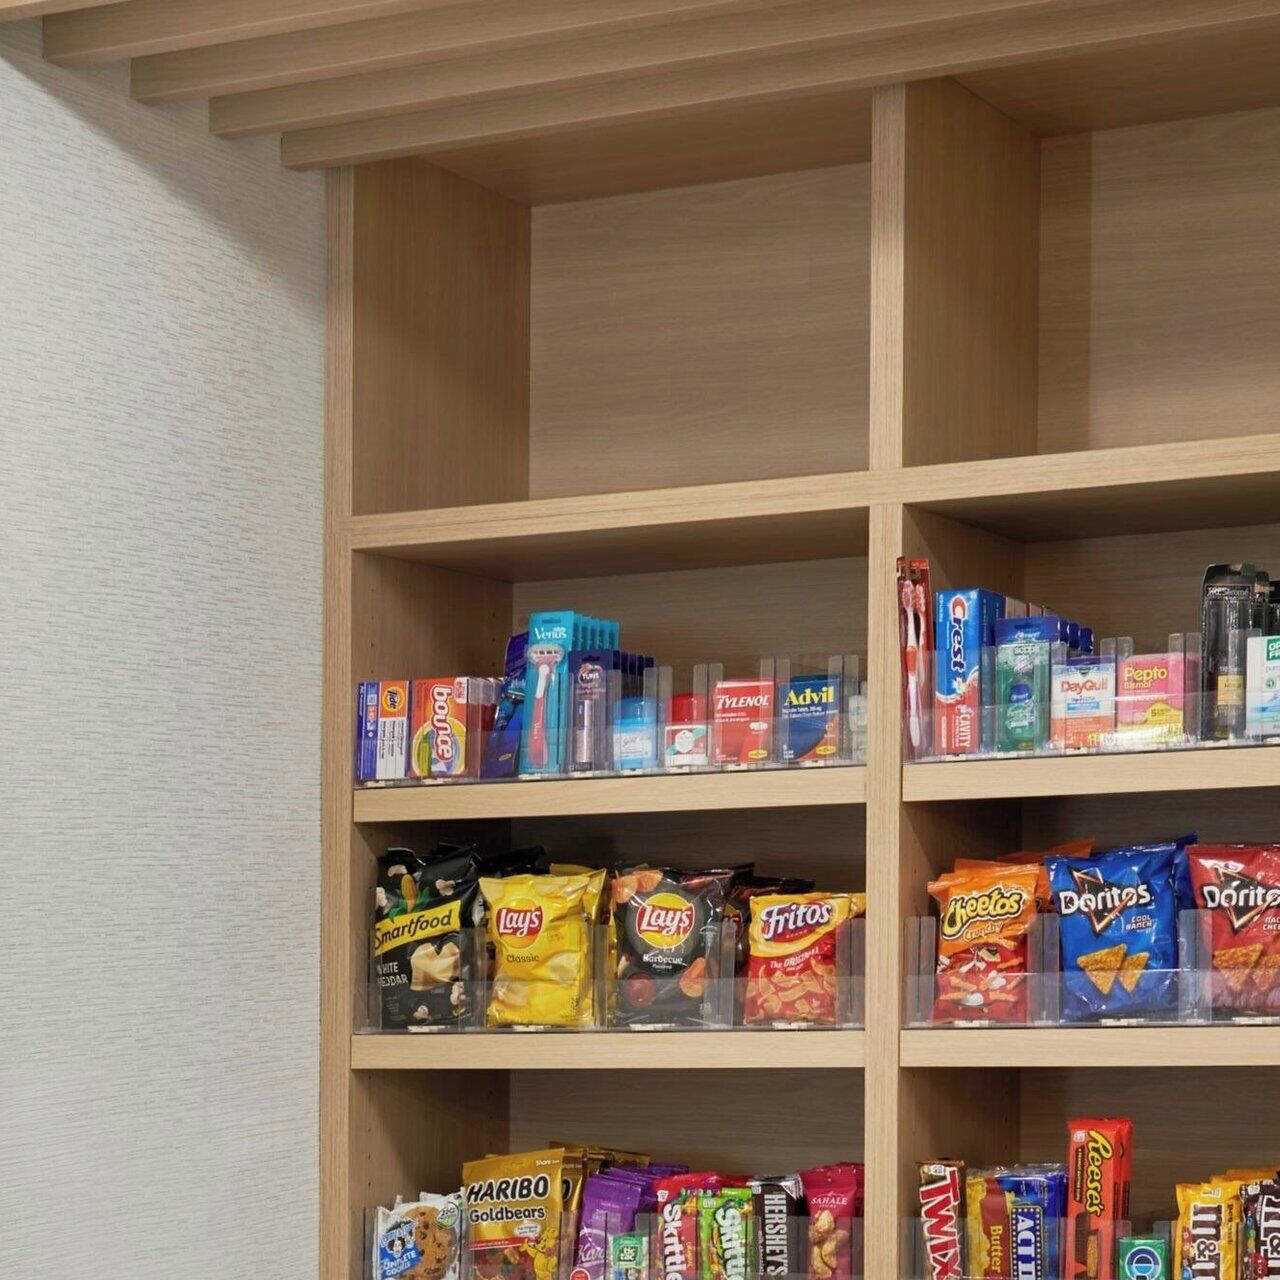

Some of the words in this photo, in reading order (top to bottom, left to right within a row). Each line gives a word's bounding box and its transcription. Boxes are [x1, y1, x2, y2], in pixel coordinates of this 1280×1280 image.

[535, 627, 567, 640] Venus
[950, 595, 968, 674] Crest
[1124, 666, 1168, 682] Pepto
[1060, 679, 1108, 694] DayQuil
[1124, 679, 1152, 690] Bismol
[716, 694, 769, 710] TYLENOL
[784, 686, 835, 706] Advil
[433, 685, 454, 761] bounce
[1059, 883, 1152, 914] Doritos
[640, 904, 693, 936] Lay's
[761, 902, 832, 940] Fritos
[942, 886, 1024, 938] Cheetos
[1130, 914, 1152, 923] COOL
[374, 909, 452, 950] Smartfood
[499, 906, 543, 938] Lay's
[964, 921, 1004, 940] Crunchy
[1125, 920, 1153, 931] RANCH
[506, 954, 540, 964] Classic
[642, 953, 683, 964] Barbecue
[1086, 1129, 1114, 1216] Reese's
[468, 1174, 550, 1204] HARIBO
[811, 1196, 848, 1206] SAHALE
[469, 1206, 546, 1223] Goldbears
[764, 1194, 788, 1276] HERSHEY'S
[1017, 1215, 1036, 1259] ACT
[620, 1253, 635, 1261] tac
[624, 1246, 636, 1254] tic
[990, 1226, 1004, 1272] Butter
